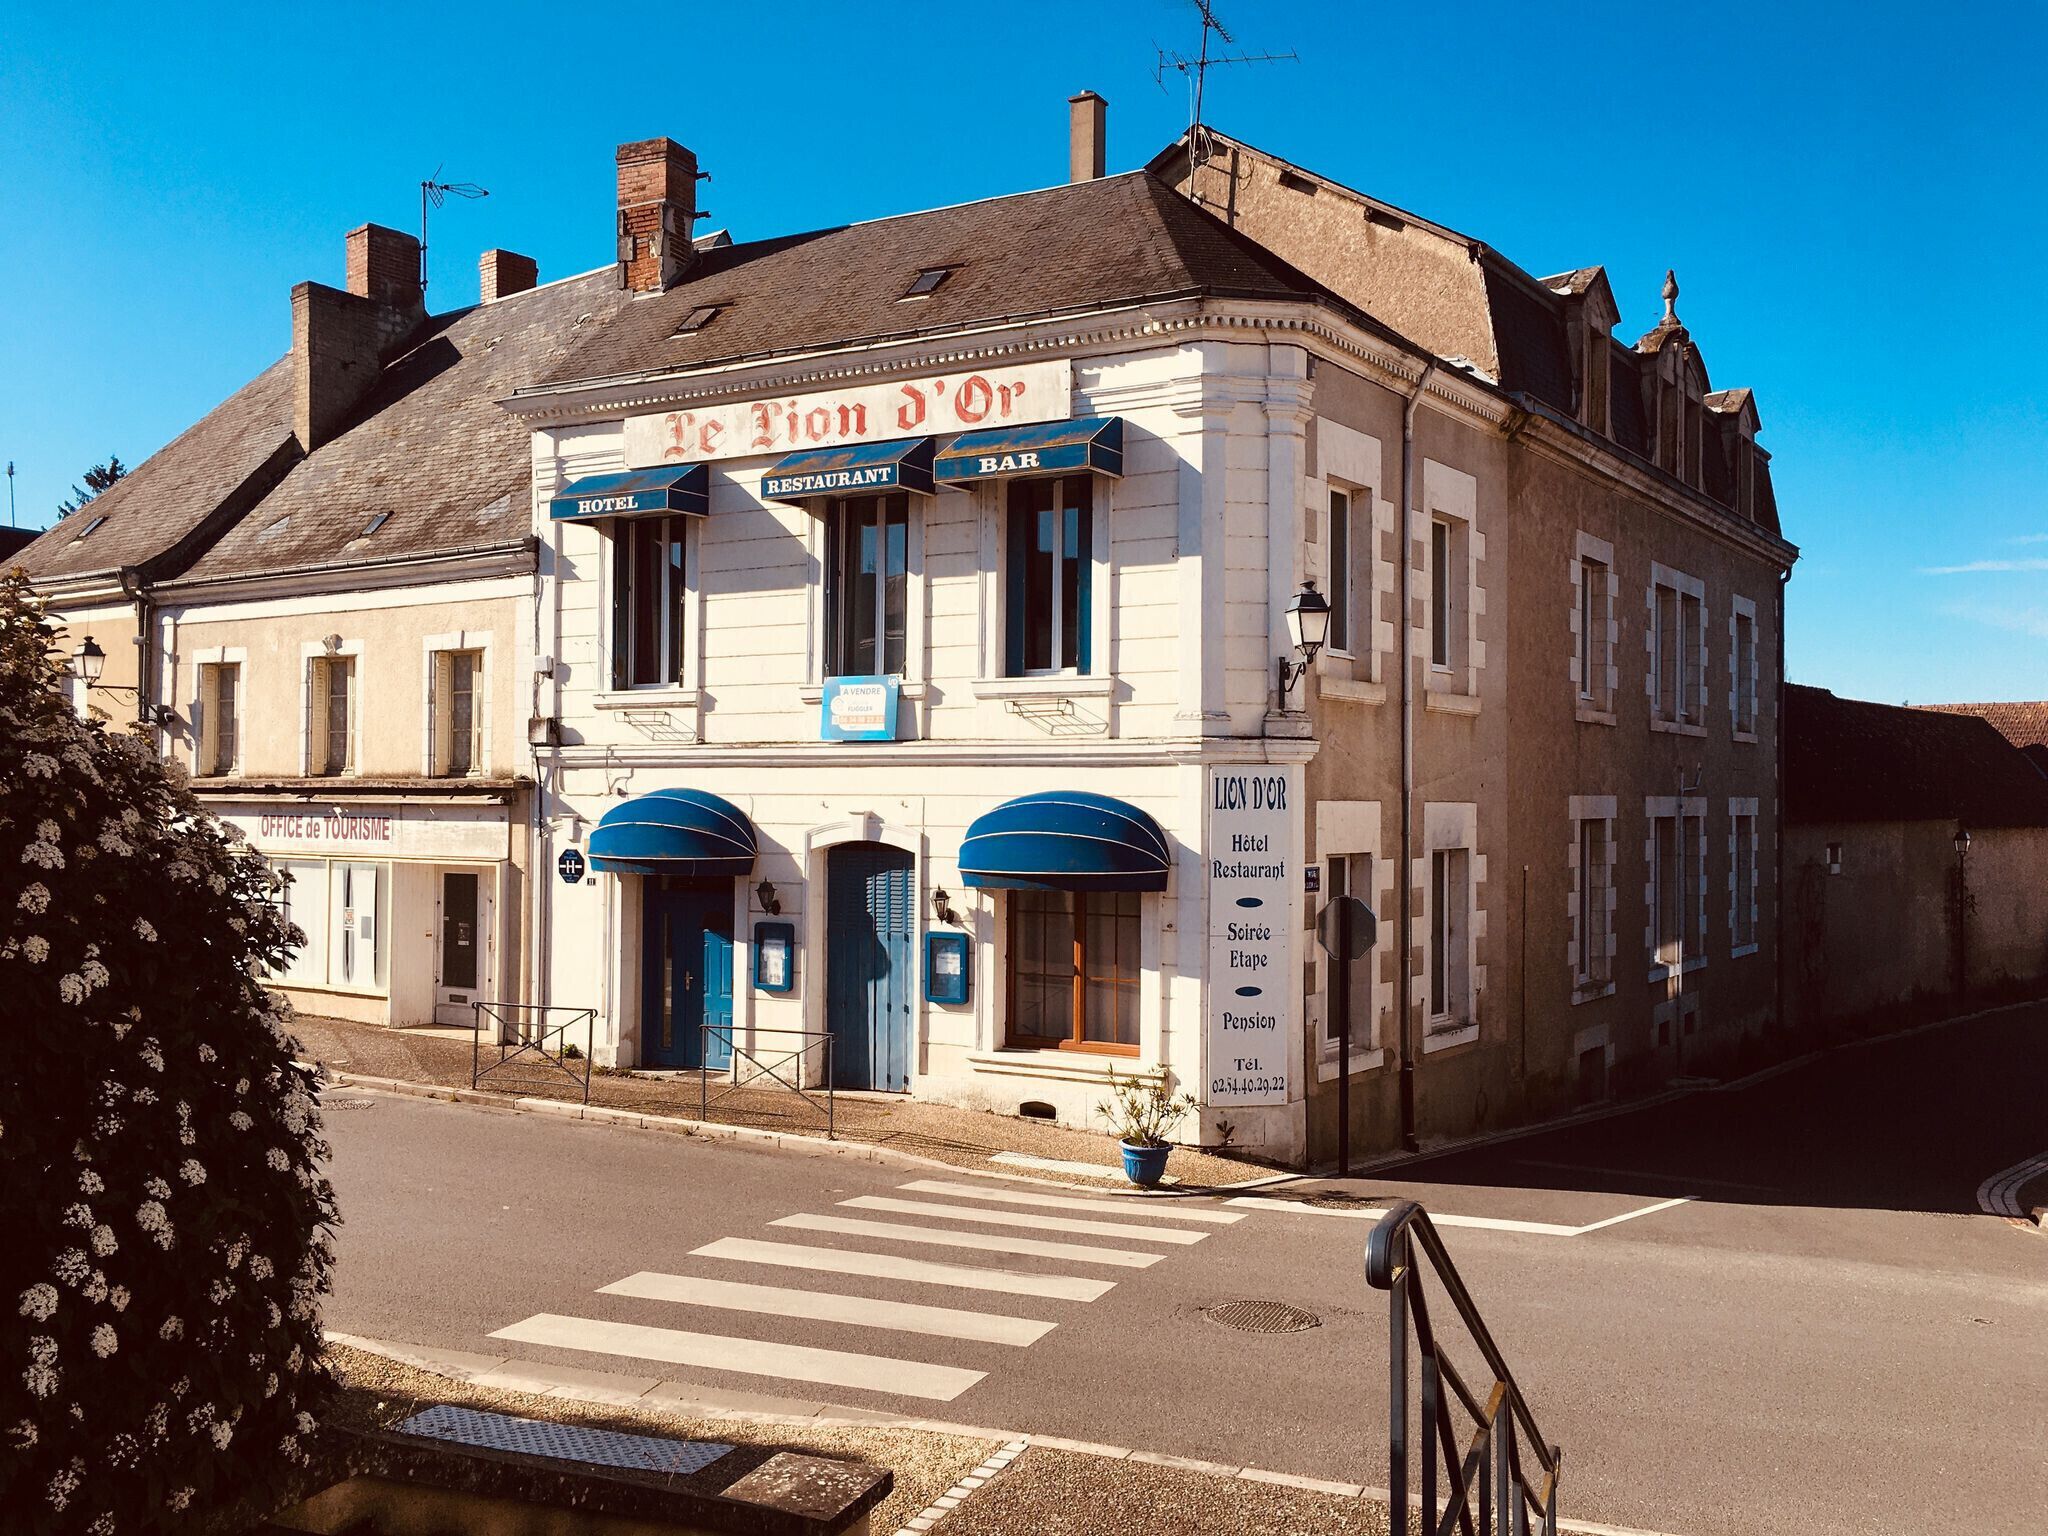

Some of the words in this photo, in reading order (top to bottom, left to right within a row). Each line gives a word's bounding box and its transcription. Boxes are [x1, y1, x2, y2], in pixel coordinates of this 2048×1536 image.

[664, 412, 725, 459] Le
[751, 400, 867, 449] Lion
[897, 375, 1026, 431] d'Or
[978, 452, 1040, 474] BAR
[766, 466, 891, 495] RESTAURANT
[577, 495, 639, 514] HOTEL
[850, 687, 881, 696] VENDRE
[1214, 776, 1248, 811] LION
[1252, 776, 1287, 811] D'OR
[261, 815, 303, 838] OFFICE
[306, 817, 320, 839] de
[324, 816, 390, 840] TOURISME
[1232, 834, 1269, 852] Hôtel
[1213, 859, 1285, 881] Restaurant
[1227, 922, 1271, 941] Soirée
[1230, 950, 1268, 971] Etape
[1223, 1011, 1276, 1032] Pension
[1234, 1058, 1263, 1071] Tél.
[1212, 1076, 1285, 1096] 02.54.40.29.22
